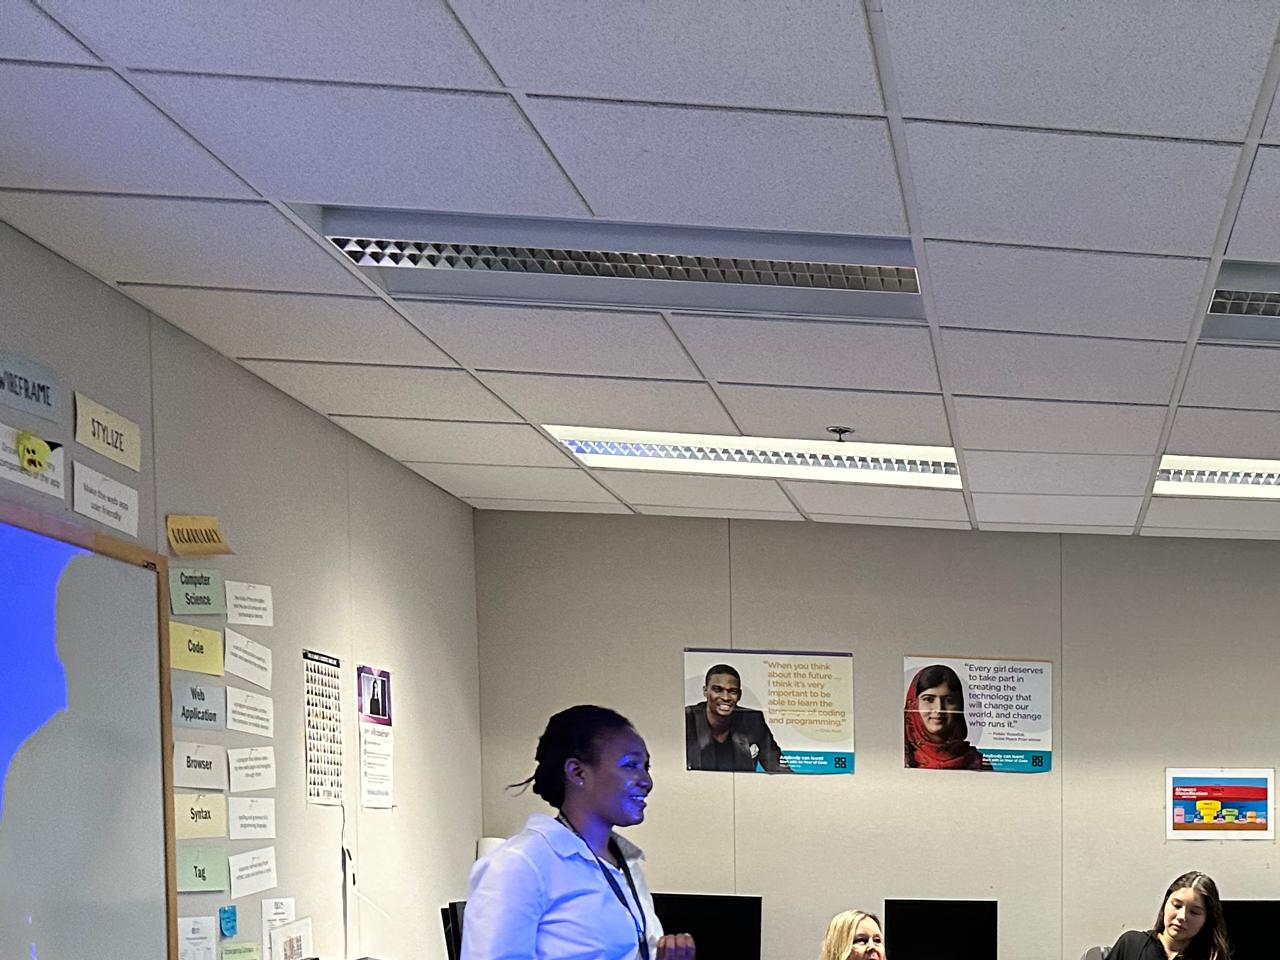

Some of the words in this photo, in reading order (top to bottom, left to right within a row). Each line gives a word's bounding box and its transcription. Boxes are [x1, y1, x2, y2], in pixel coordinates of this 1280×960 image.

[91, 417, 125, 452] STYLIZE
[180, 571, 211, 588] Computer
[185, 592, 212, 606] Science
[187, 639, 204, 654] Code
[794, 663, 808, 671] you
[993, 666, 1007, 674] girl
[1008, 665, 1044, 674] deserves
[768, 671, 792, 679] about
[793, 671, 806, 679] the
[979, 674, 997, 682] take
[998, 675, 1015, 683] part
[772, 680, 793, 688] think
[968, 683, 1002, 692] creating
[1003, 684, 1017, 692] the
[190, 687, 205, 701] Web
[968, 692, 1014, 702] technology
[983, 702, 1014, 711] change
[181, 705, 217, 723] Application
[817, 709, 846, 718] coding
[995, 711, 1011, 719] and
[1012, 712, 1042, 721] change
[186, 755, 213, 770] Browser
[190, 807, 212, 823] Syntax
[193, 865, 207, 881] Tag
